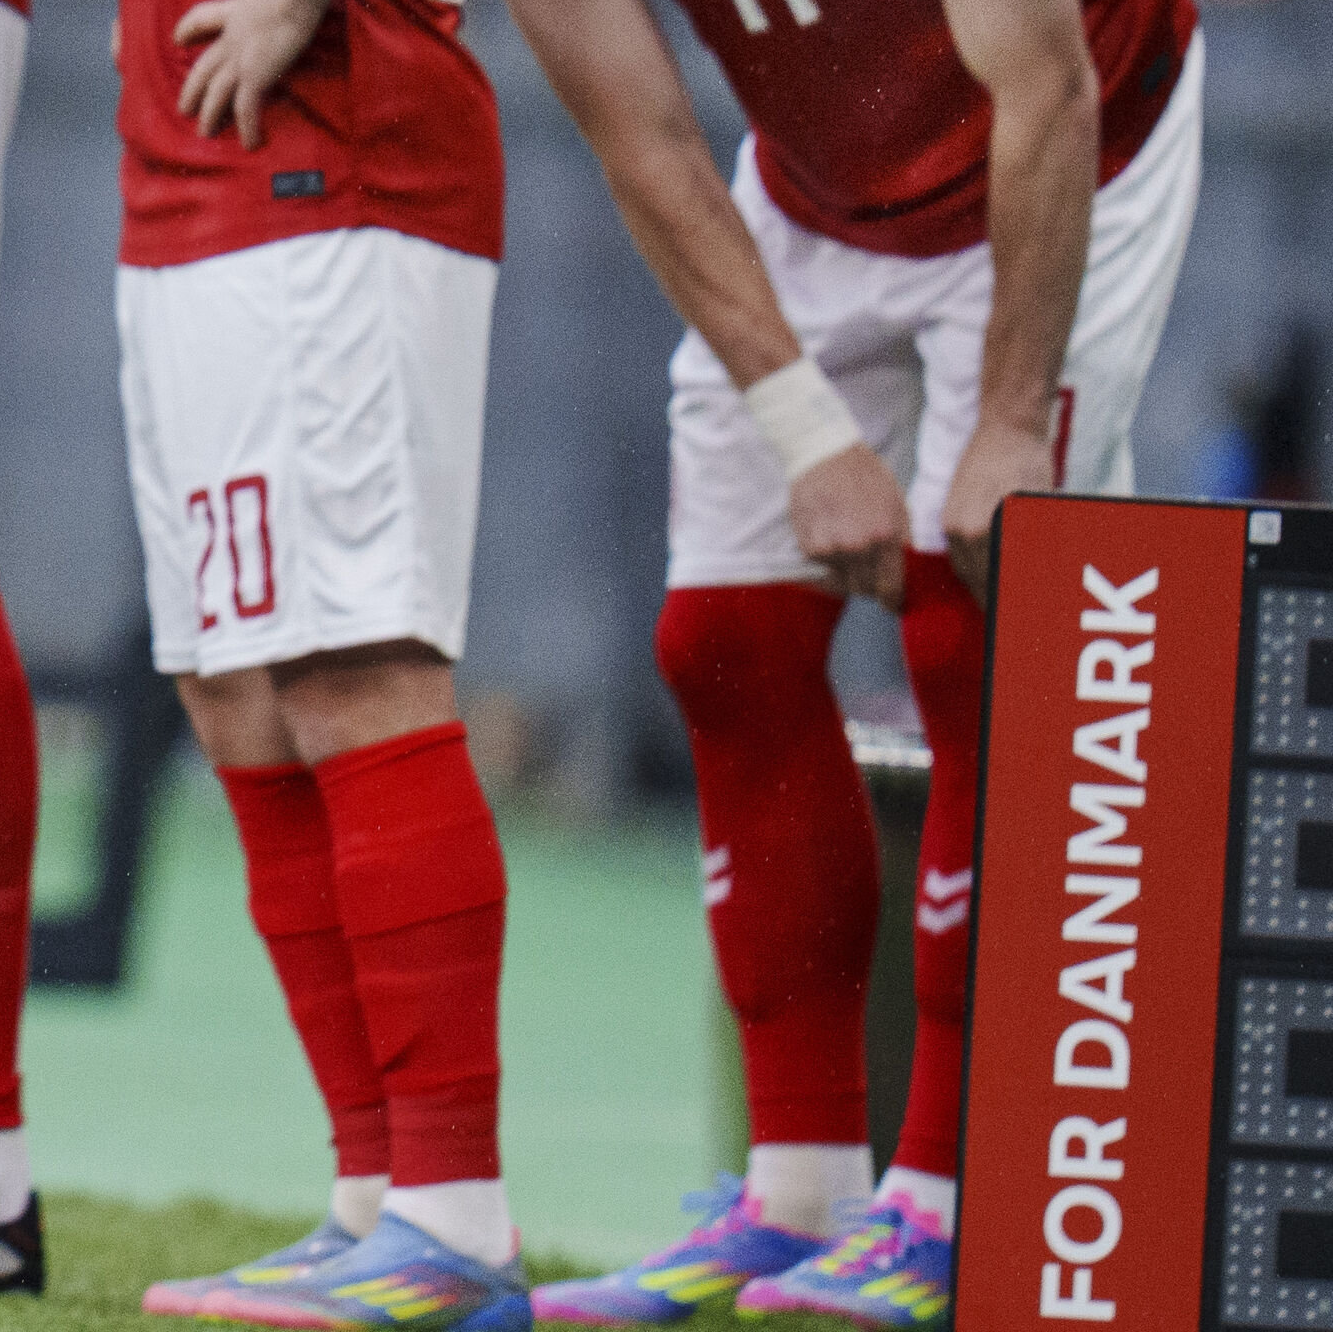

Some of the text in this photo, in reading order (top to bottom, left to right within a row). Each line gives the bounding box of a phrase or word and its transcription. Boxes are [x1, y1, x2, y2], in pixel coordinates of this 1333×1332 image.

[187, 473, 277, 633] 20
[1039, 562, 1161, 1323] FOR DANMARK
